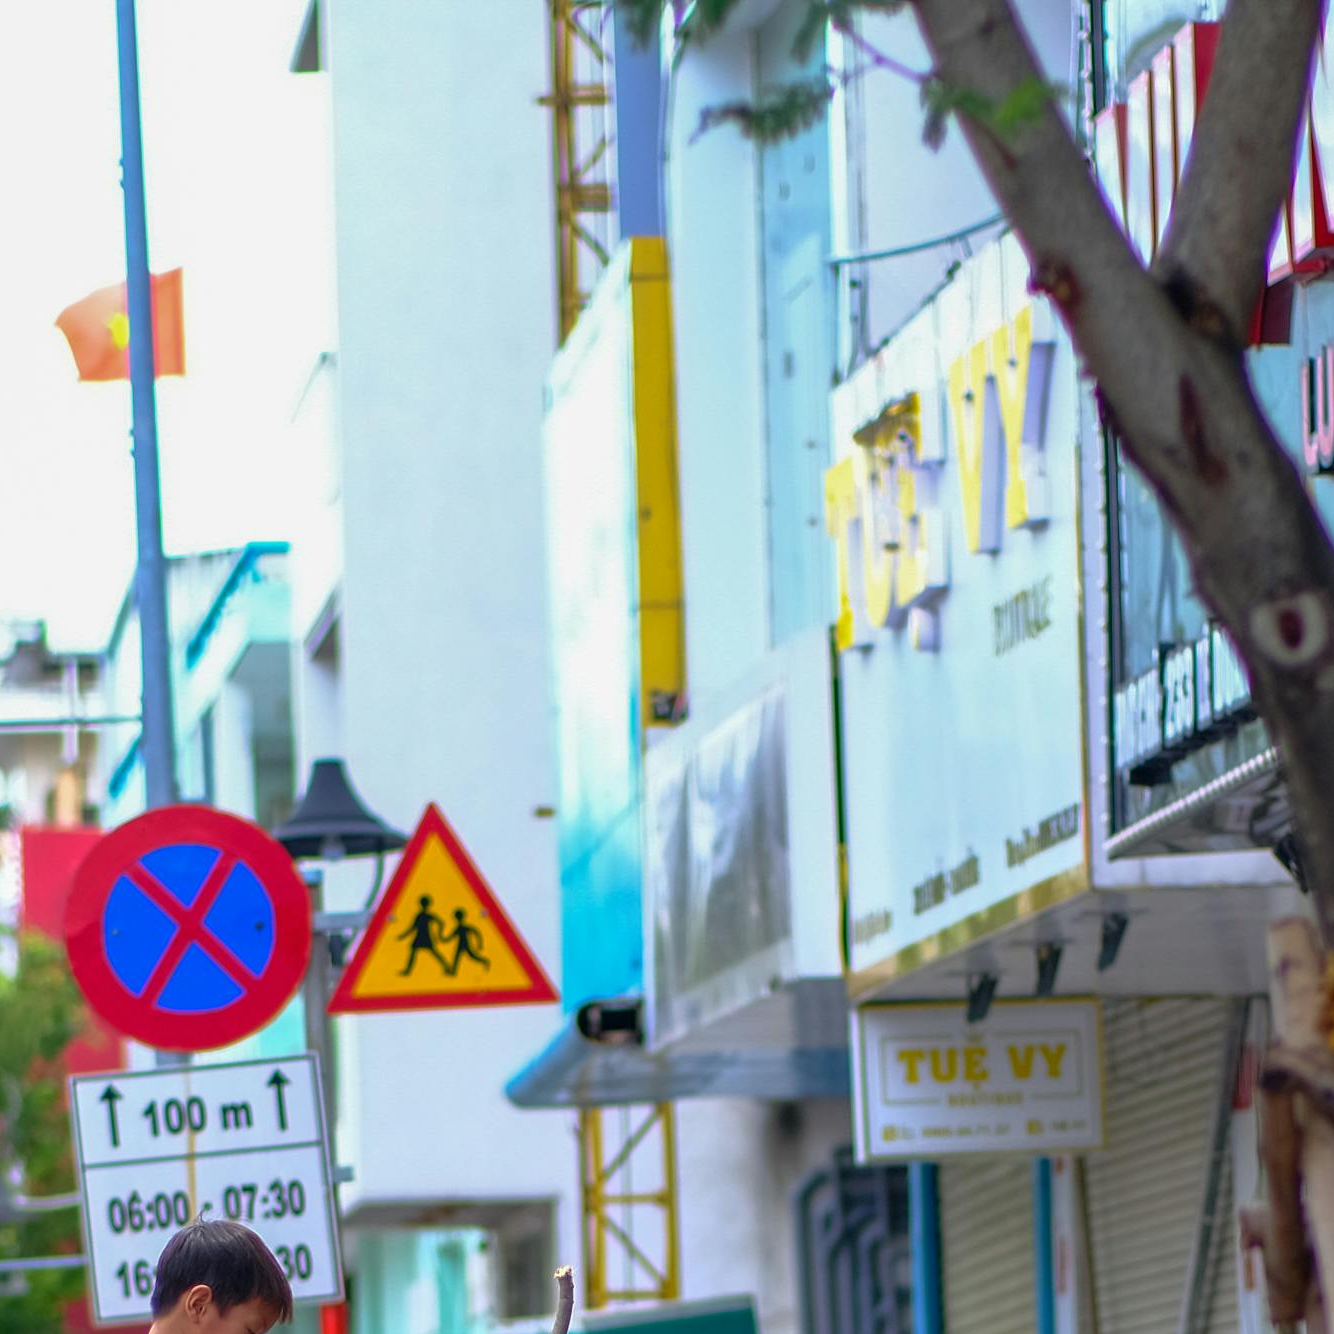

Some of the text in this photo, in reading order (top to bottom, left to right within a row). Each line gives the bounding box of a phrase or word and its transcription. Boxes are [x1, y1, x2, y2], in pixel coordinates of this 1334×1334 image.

[949, 306, 1033, 557] VY
[1007, 1043, 1066, 1081] VY
[142, 1095, 253, 1138] 100 m
[107, 1189, 190, 1234] 06:00
[223, 1179, 306, 1220] 07:30
